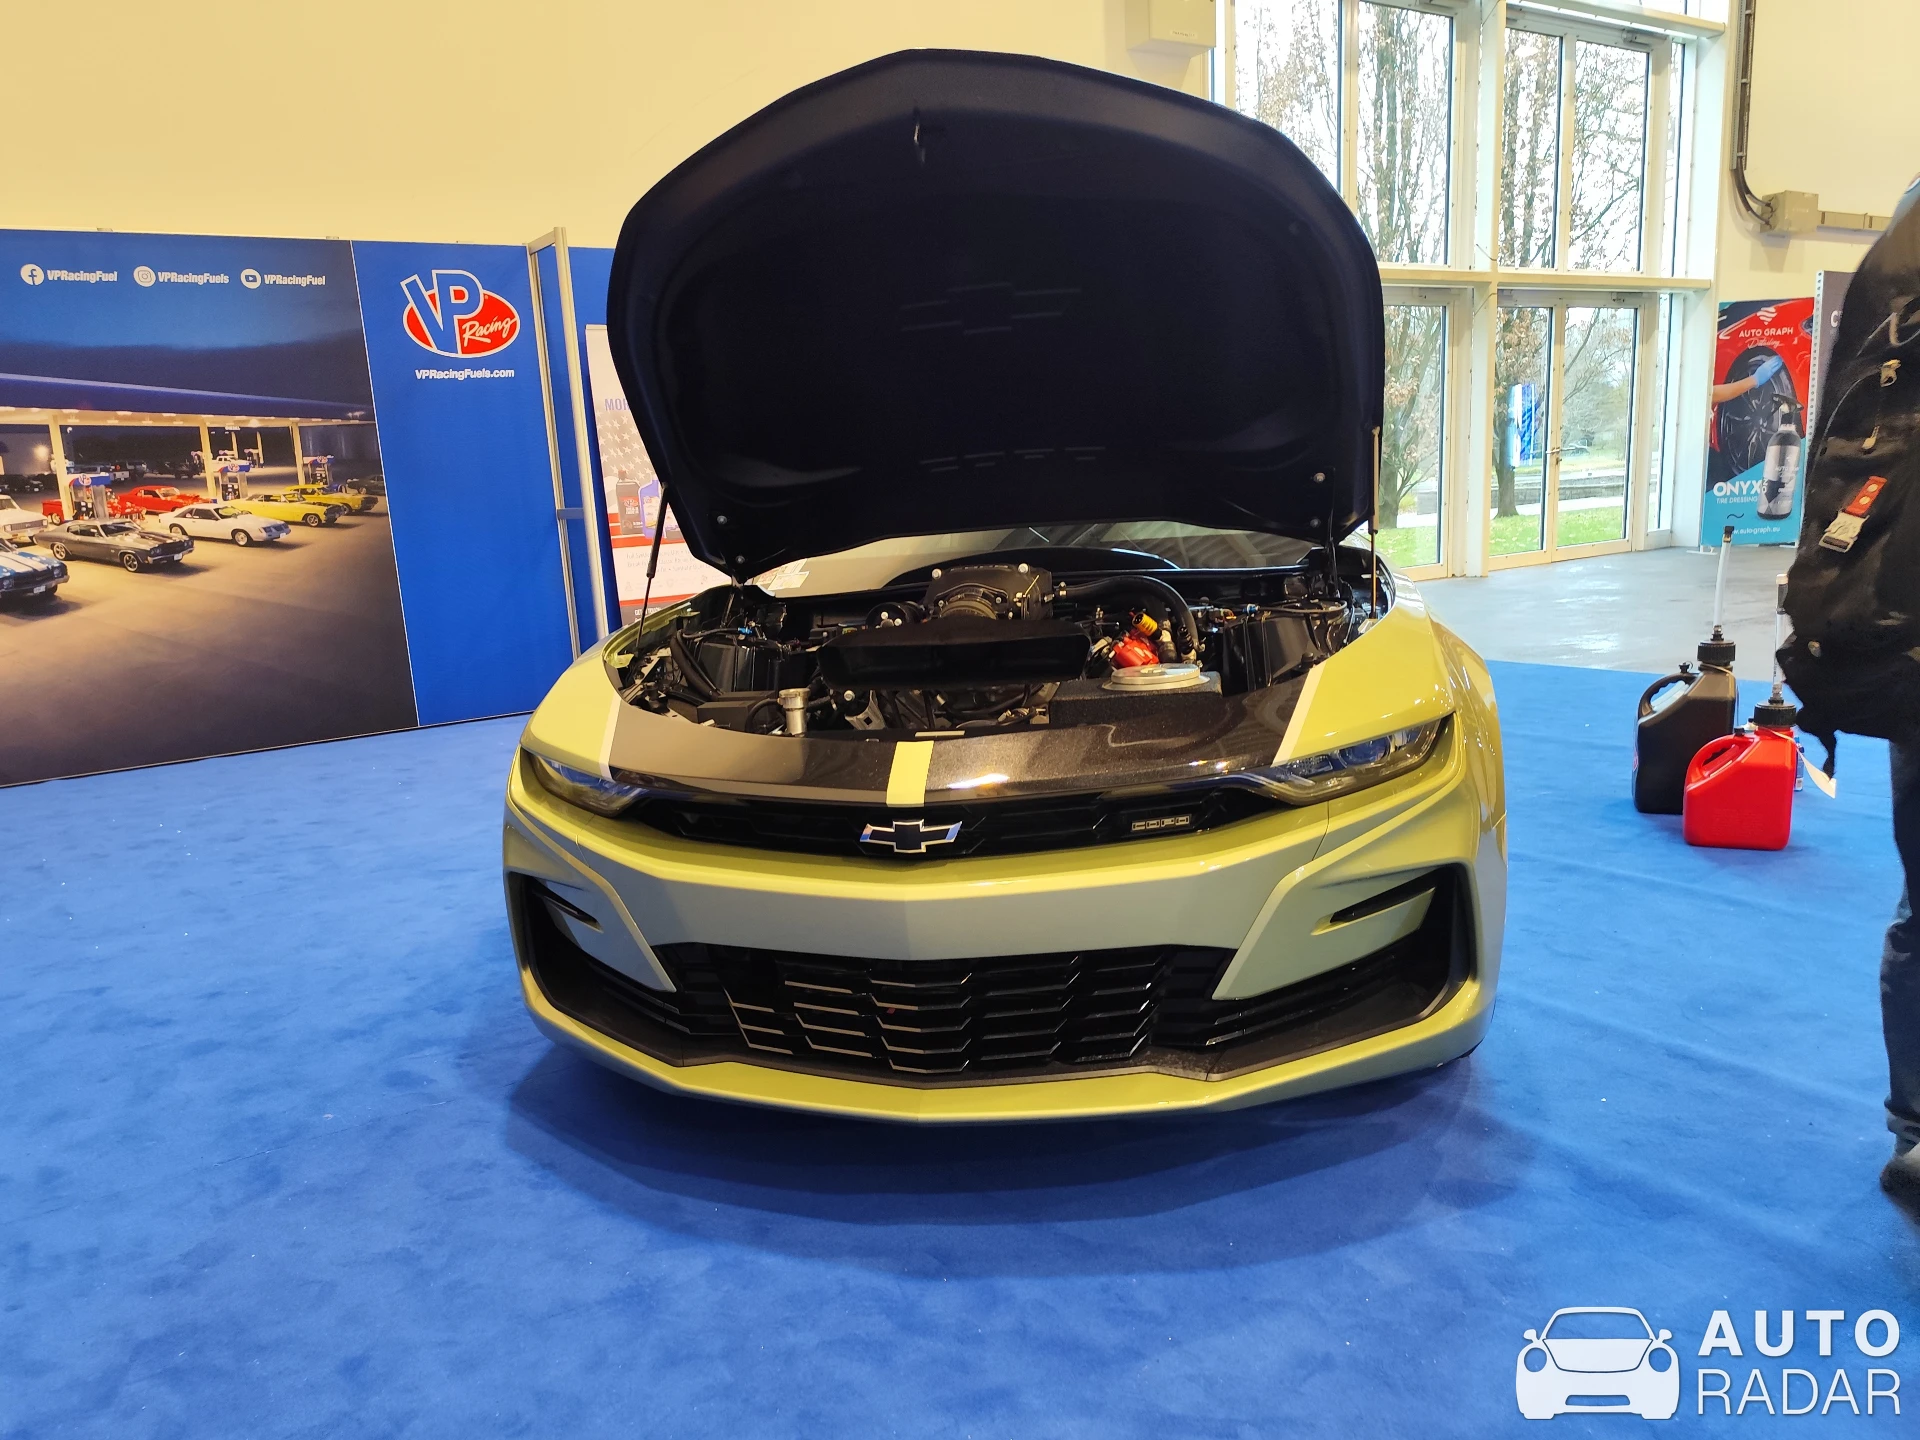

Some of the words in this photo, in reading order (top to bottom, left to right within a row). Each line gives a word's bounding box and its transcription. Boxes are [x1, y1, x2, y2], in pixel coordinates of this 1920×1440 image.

[47, 269, 118, 283] VPRacingFuel
[158, 271, 230, 286] VPRacingFuels
[264, 273, 326, 287] VPRacingFuel
[400, 270, 484, 356] VP
[462, 316, 517, 347] Racing
[1739, 329, 1762, 338] AUTO
[1764, 327, 1794, 337] GRAPH
[415, 368, 515, 380] VPRacingFuels.com
[1713, 480, 1762, 497] ONYX
[1733, 525, 1781, 535] w.auto-graph.eu
[1131, 815, 1190, 831] COPO
